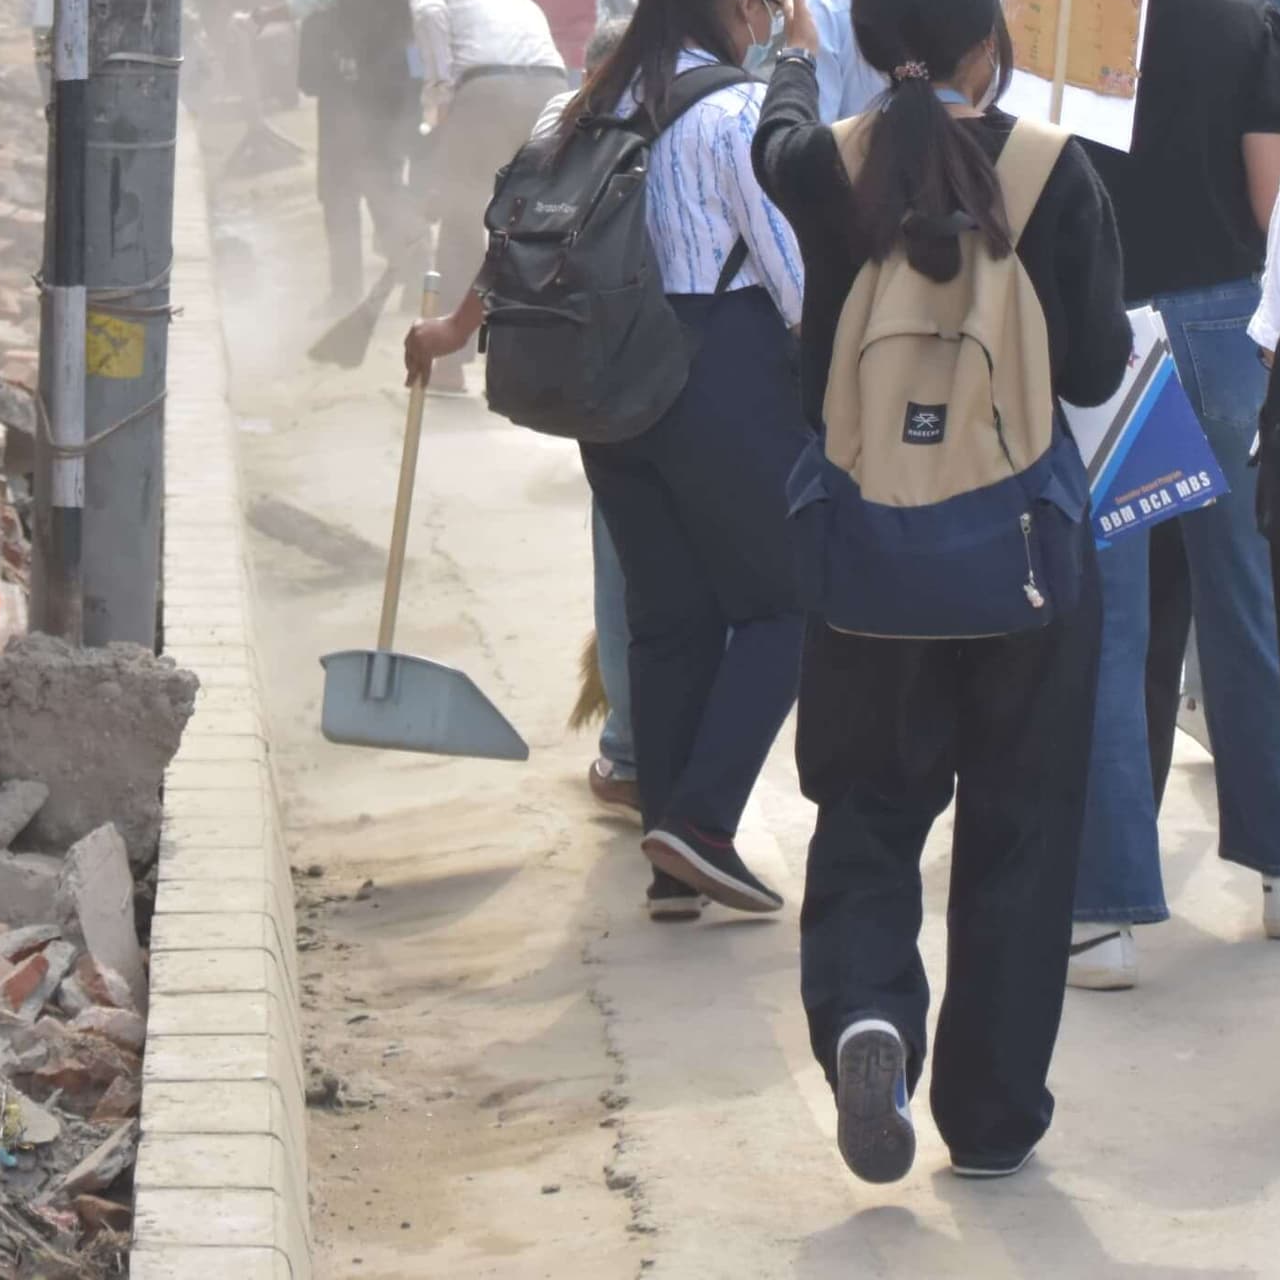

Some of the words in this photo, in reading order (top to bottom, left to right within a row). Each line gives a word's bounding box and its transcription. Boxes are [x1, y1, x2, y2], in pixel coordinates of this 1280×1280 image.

[1099, 505, 1136, 532] BBM
[1139, 489, 1173, 514] BCA
[1175, 471, 1211, 498] MBS
